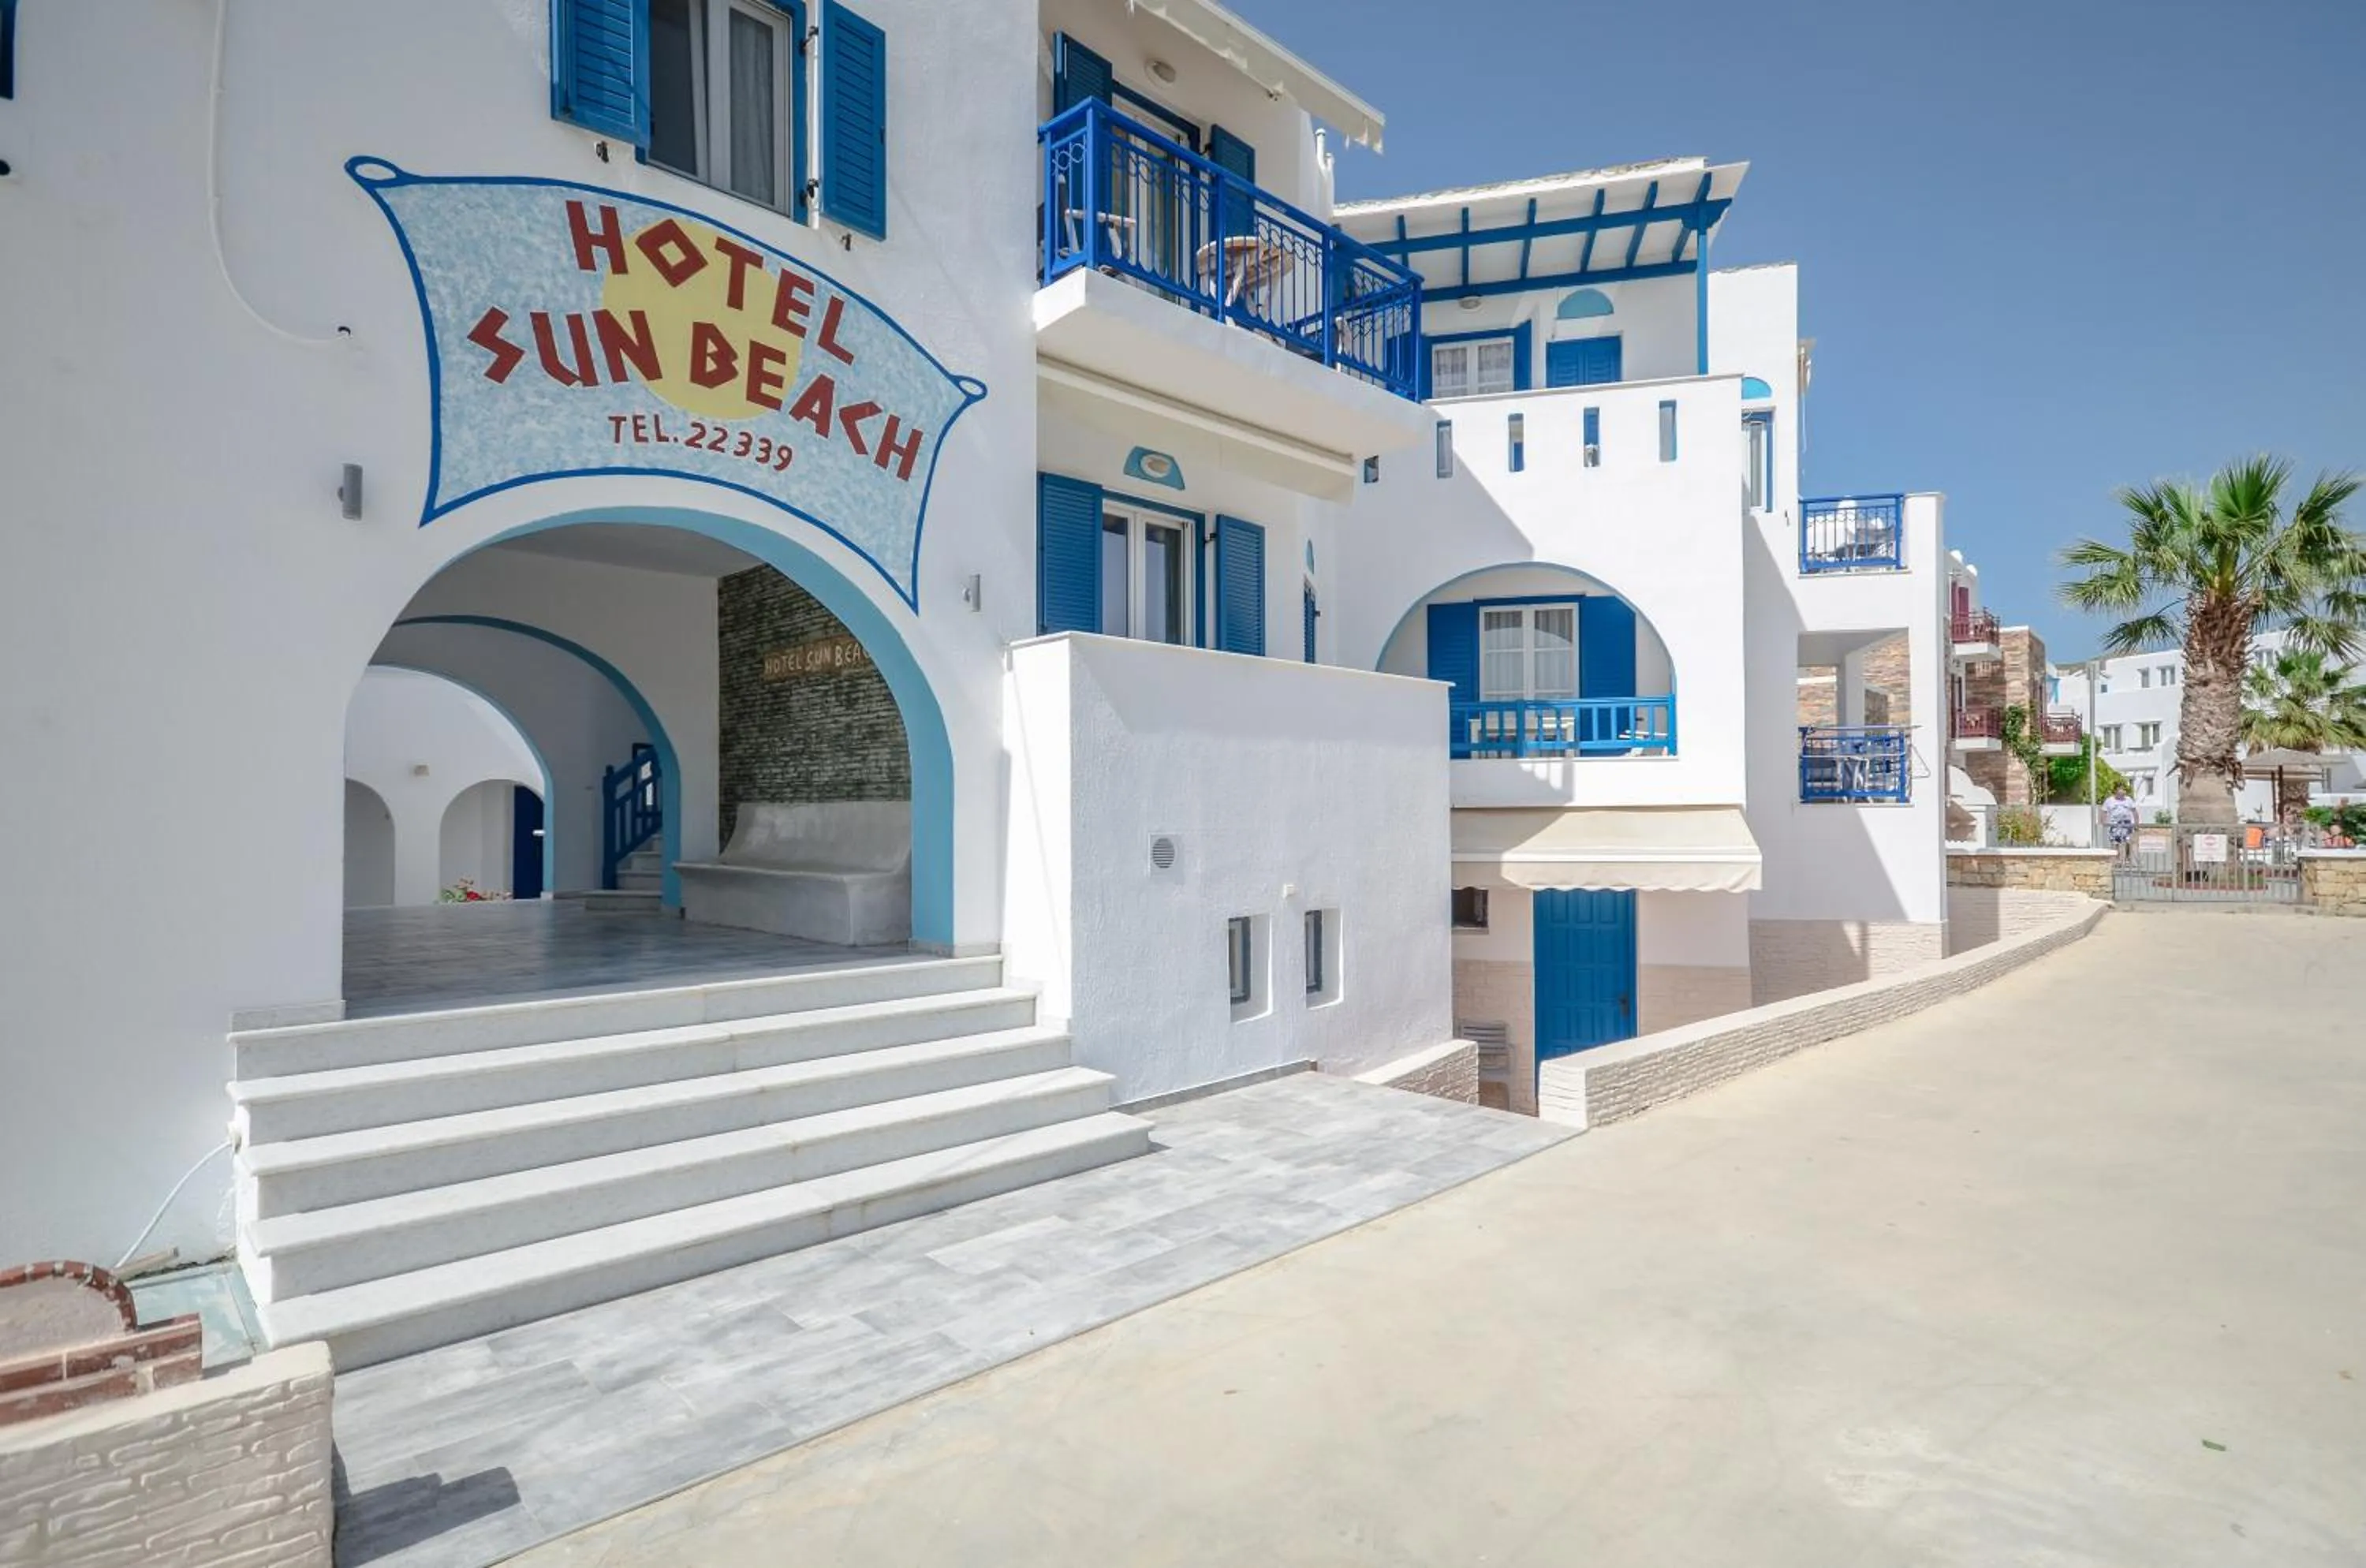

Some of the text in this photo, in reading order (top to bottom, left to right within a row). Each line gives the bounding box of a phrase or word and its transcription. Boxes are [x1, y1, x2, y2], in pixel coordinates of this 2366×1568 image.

[566, 200, 854, 365] HOTEL
[467, 307, 923, 481] SUN BEACH
[764, 653, 802, 674] HOTEL
[804, 646, 831, 671] SUN
